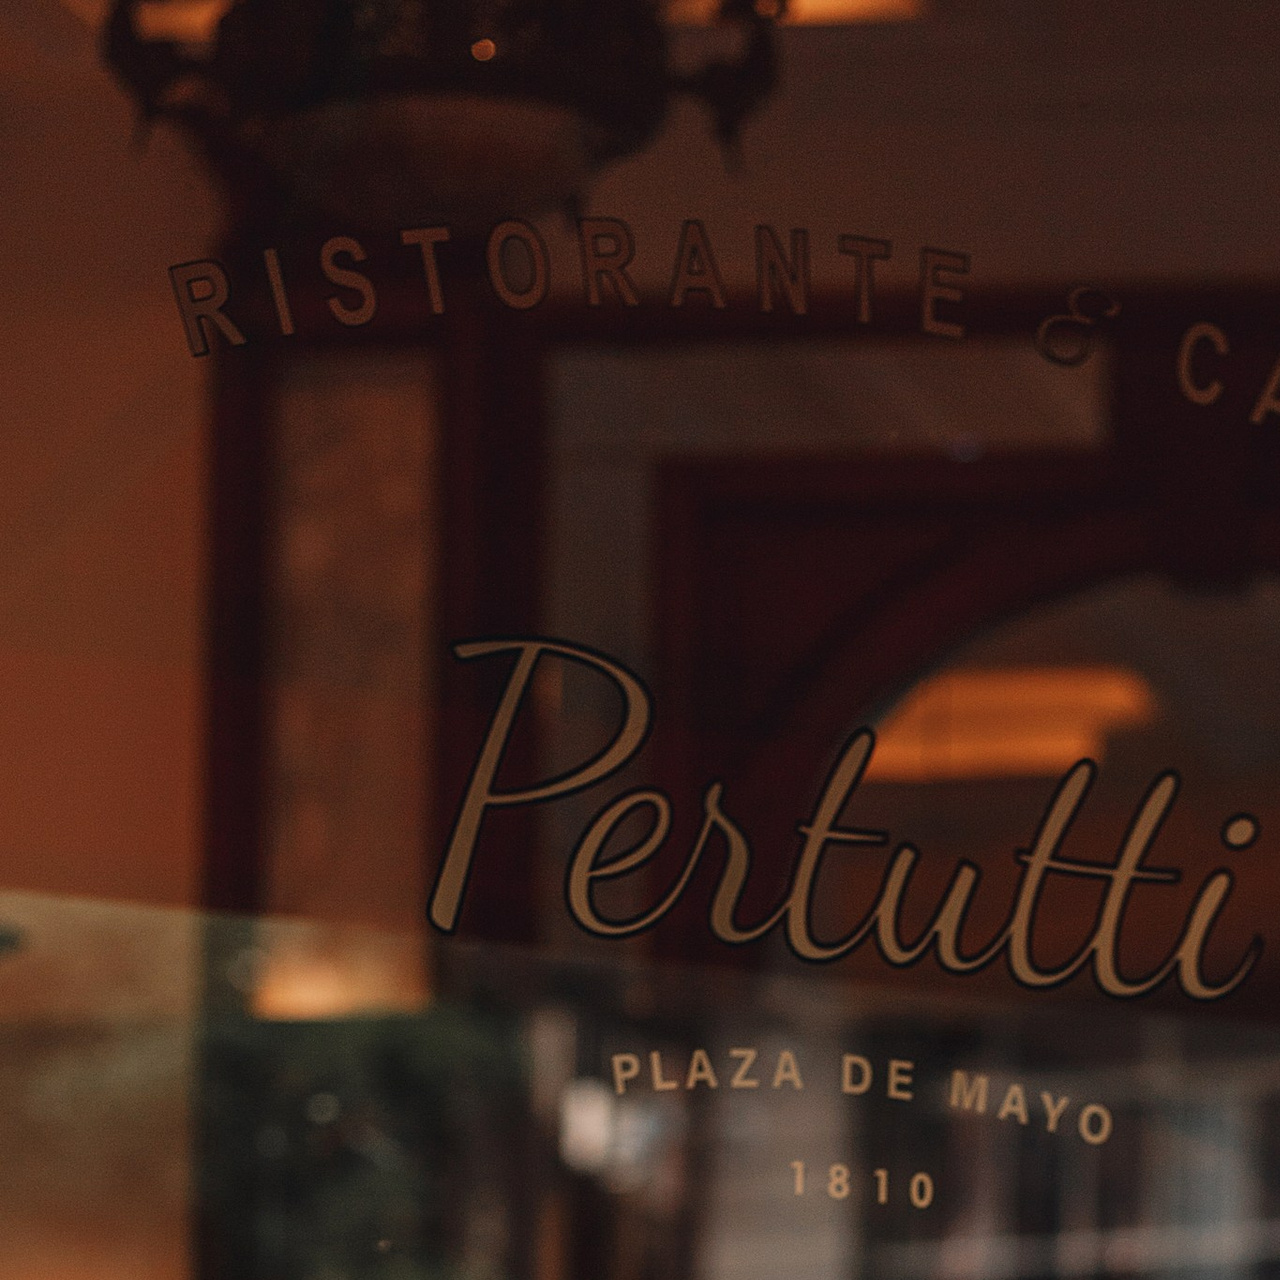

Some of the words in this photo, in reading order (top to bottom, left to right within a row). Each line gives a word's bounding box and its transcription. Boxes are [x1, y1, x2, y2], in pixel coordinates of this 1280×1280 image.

[168, 216, 972, 358] RISTORANTE
[427, 634, 1264, 1000] Pertutti
[611, 1048, 804, 1095] PLAZA
[841, 1054, 914, 1101] DE
[949, 1069, 1114, 1145] MAYO
[789, 1160, 934, 1209] 1810
